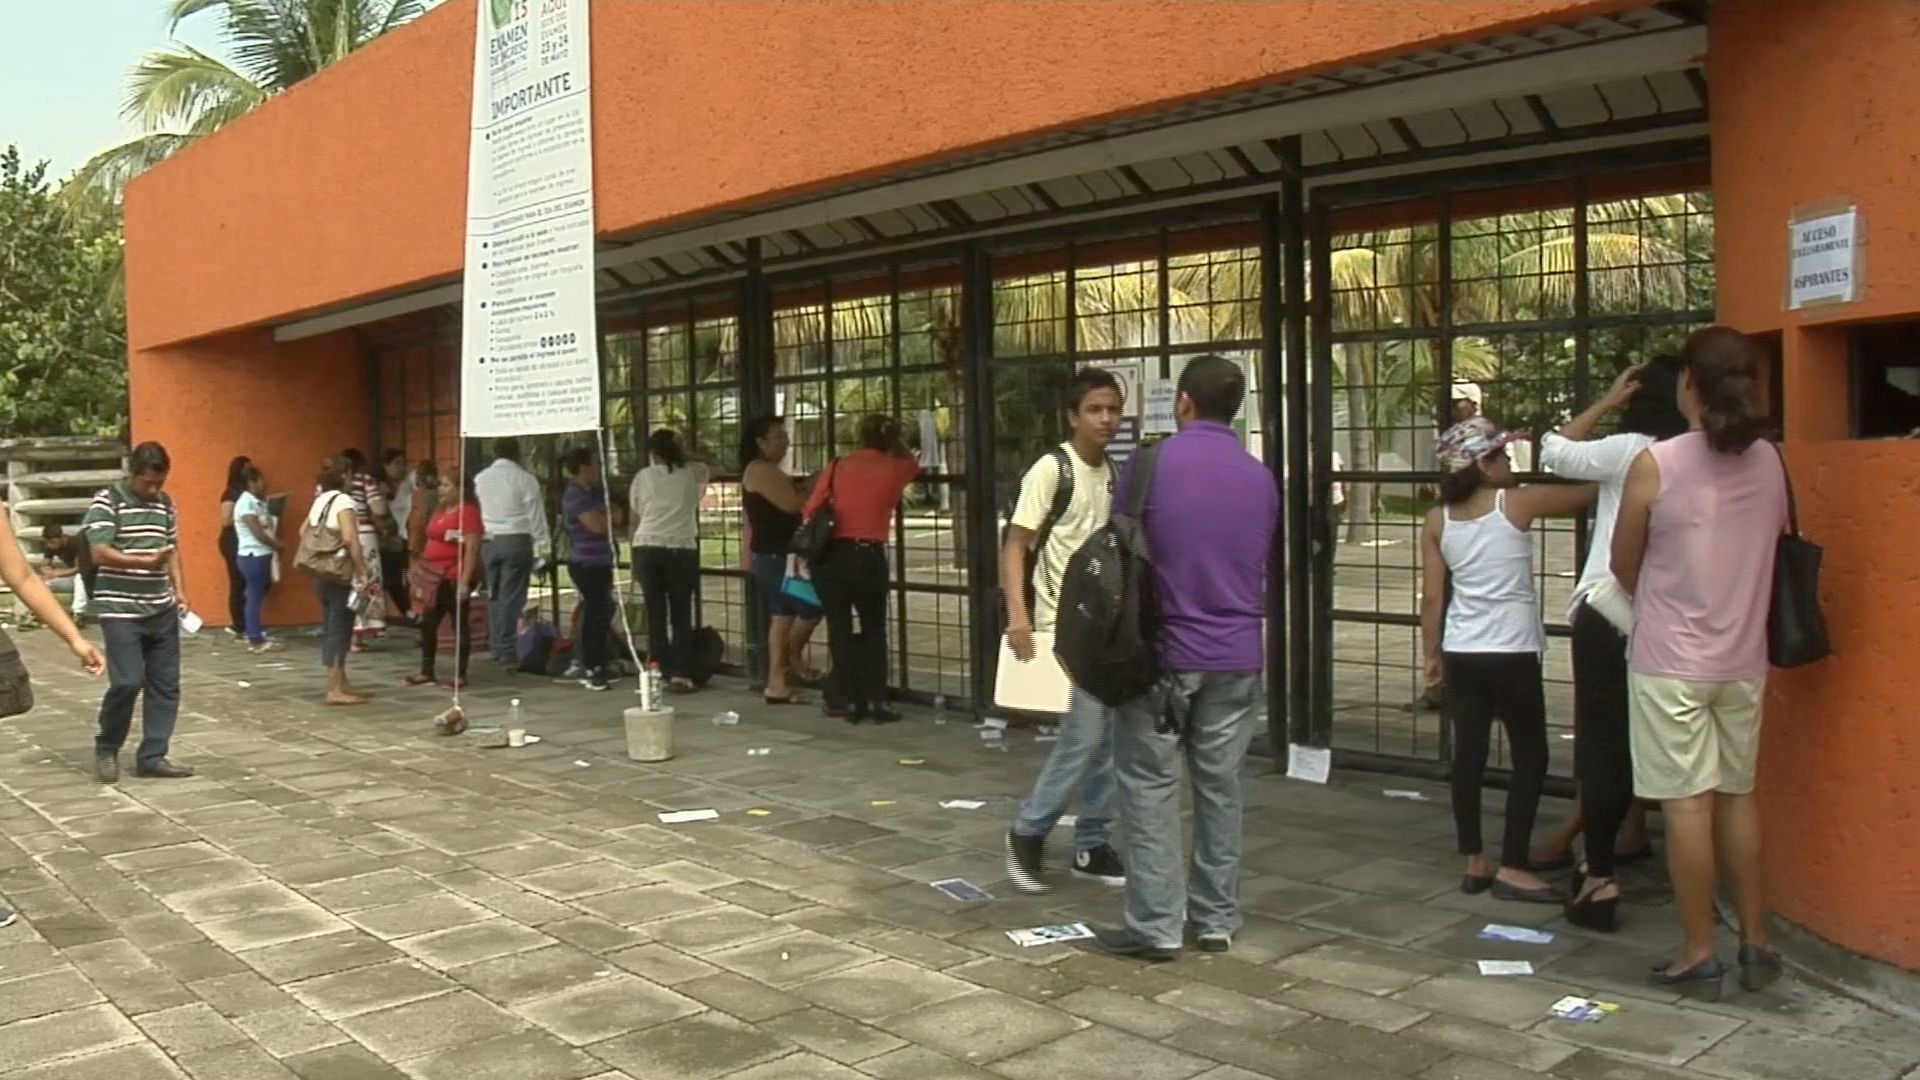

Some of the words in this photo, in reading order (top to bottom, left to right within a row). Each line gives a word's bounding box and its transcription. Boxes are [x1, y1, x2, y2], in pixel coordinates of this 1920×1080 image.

[490, 21, 528, 54] EXAMEN
[541, 41, 550, 54] 23
[491, 71, 571, 120] IMPORTANTE
[1802, 225, 1837, 243] ACCESO
[1794, 267, 1849, 289] ASPIRANTES
